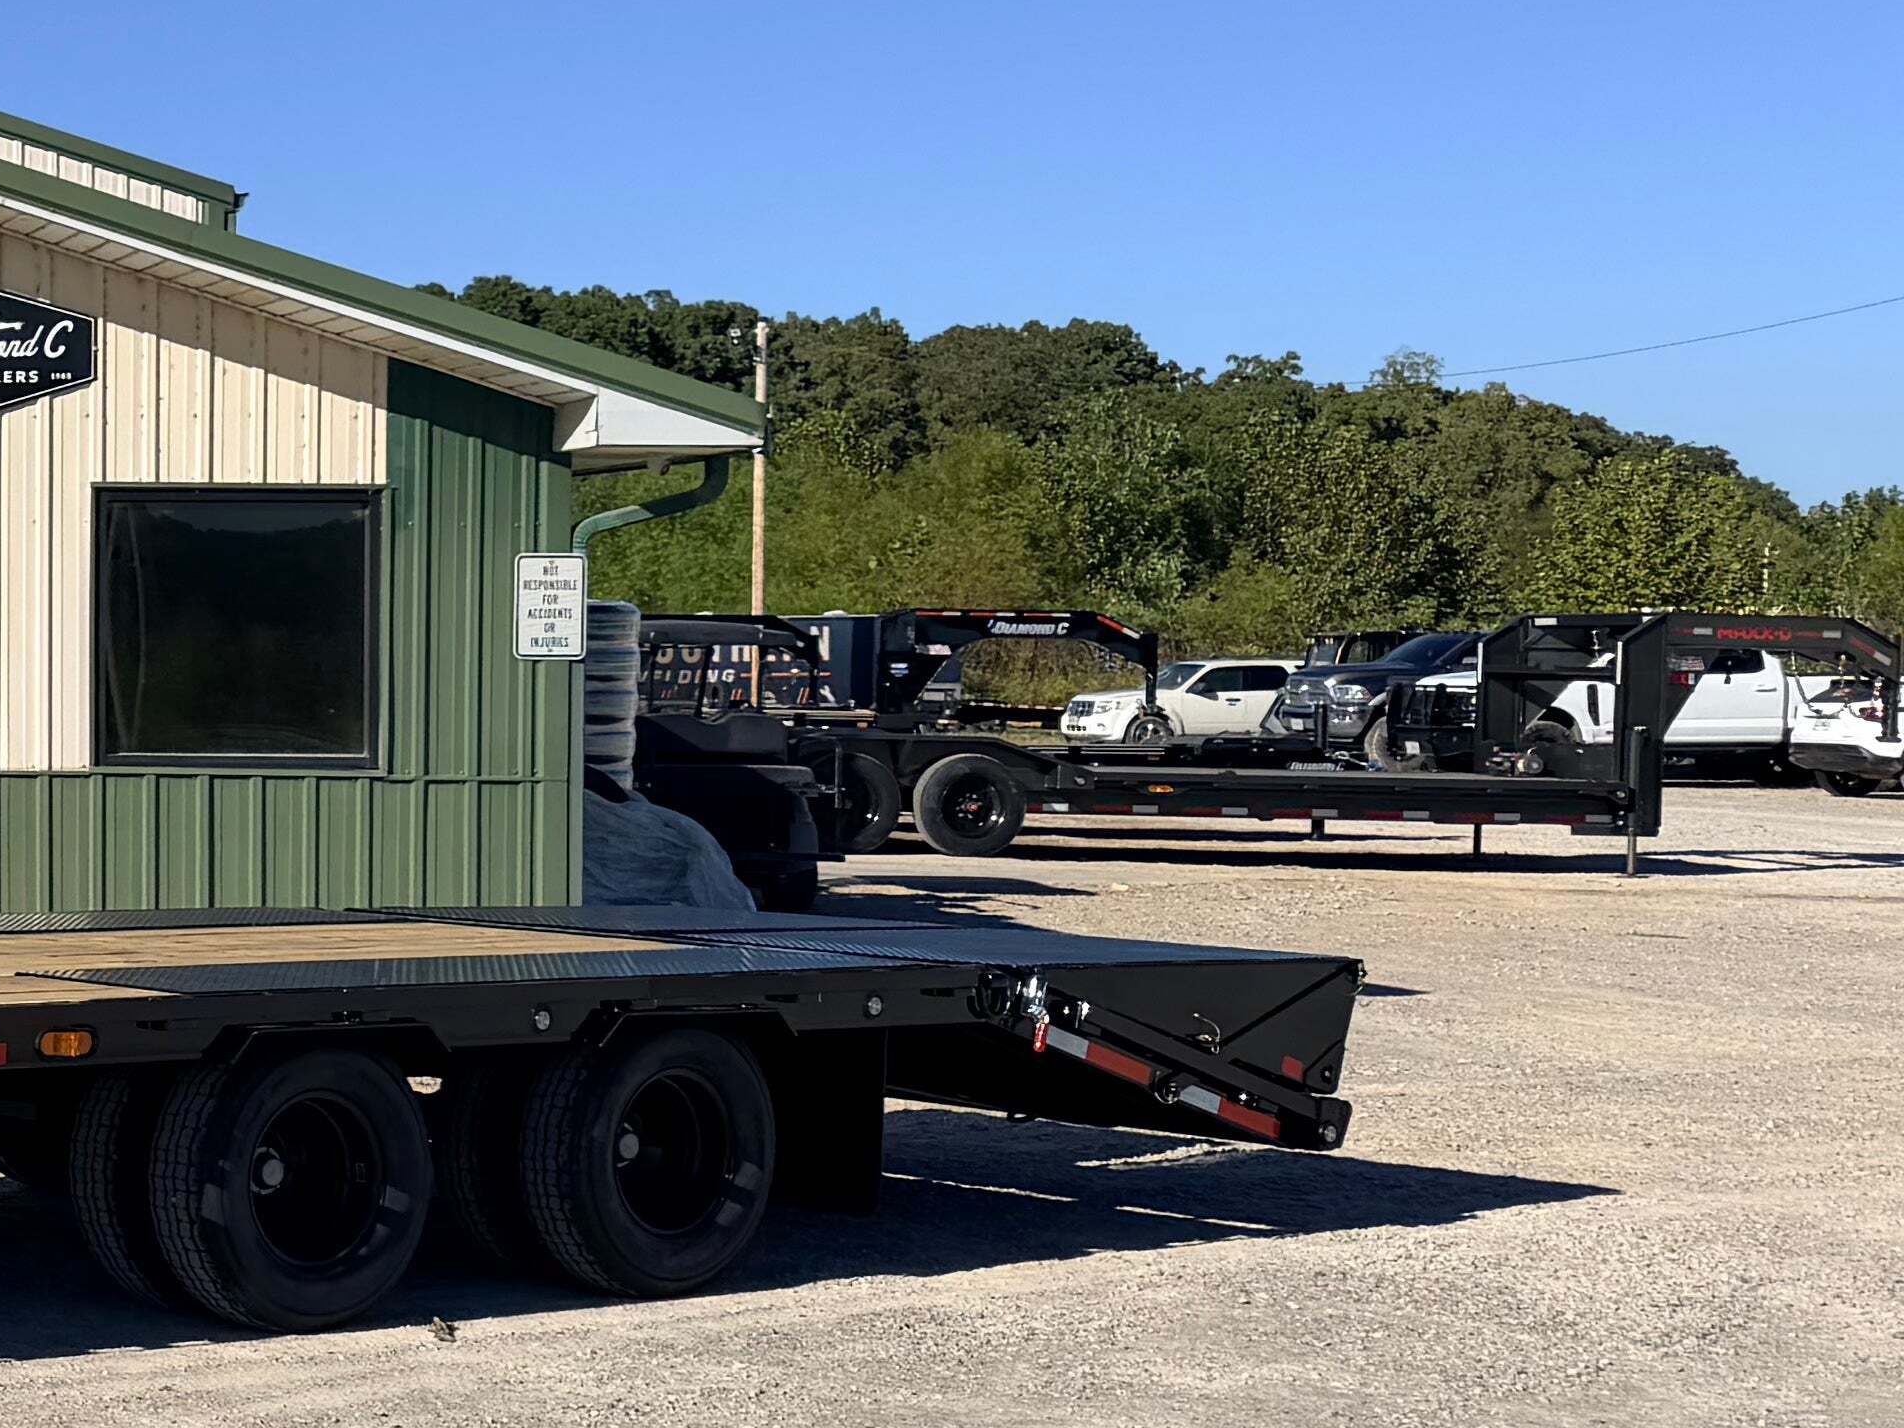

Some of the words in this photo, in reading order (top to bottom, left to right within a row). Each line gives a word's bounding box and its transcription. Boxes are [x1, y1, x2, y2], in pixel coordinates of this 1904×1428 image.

[43, 320, 74, 359] C
[523, 579, 578, 590] RESPONSIBLE
[542, 594, 559, 605] FOR
[527, 608, 573, 619] ACCIDENTS
[544, 622, 555, 633] OR
[1056, 622, 1071, 636] C
[530, 637, 569, 648] INJURIES
